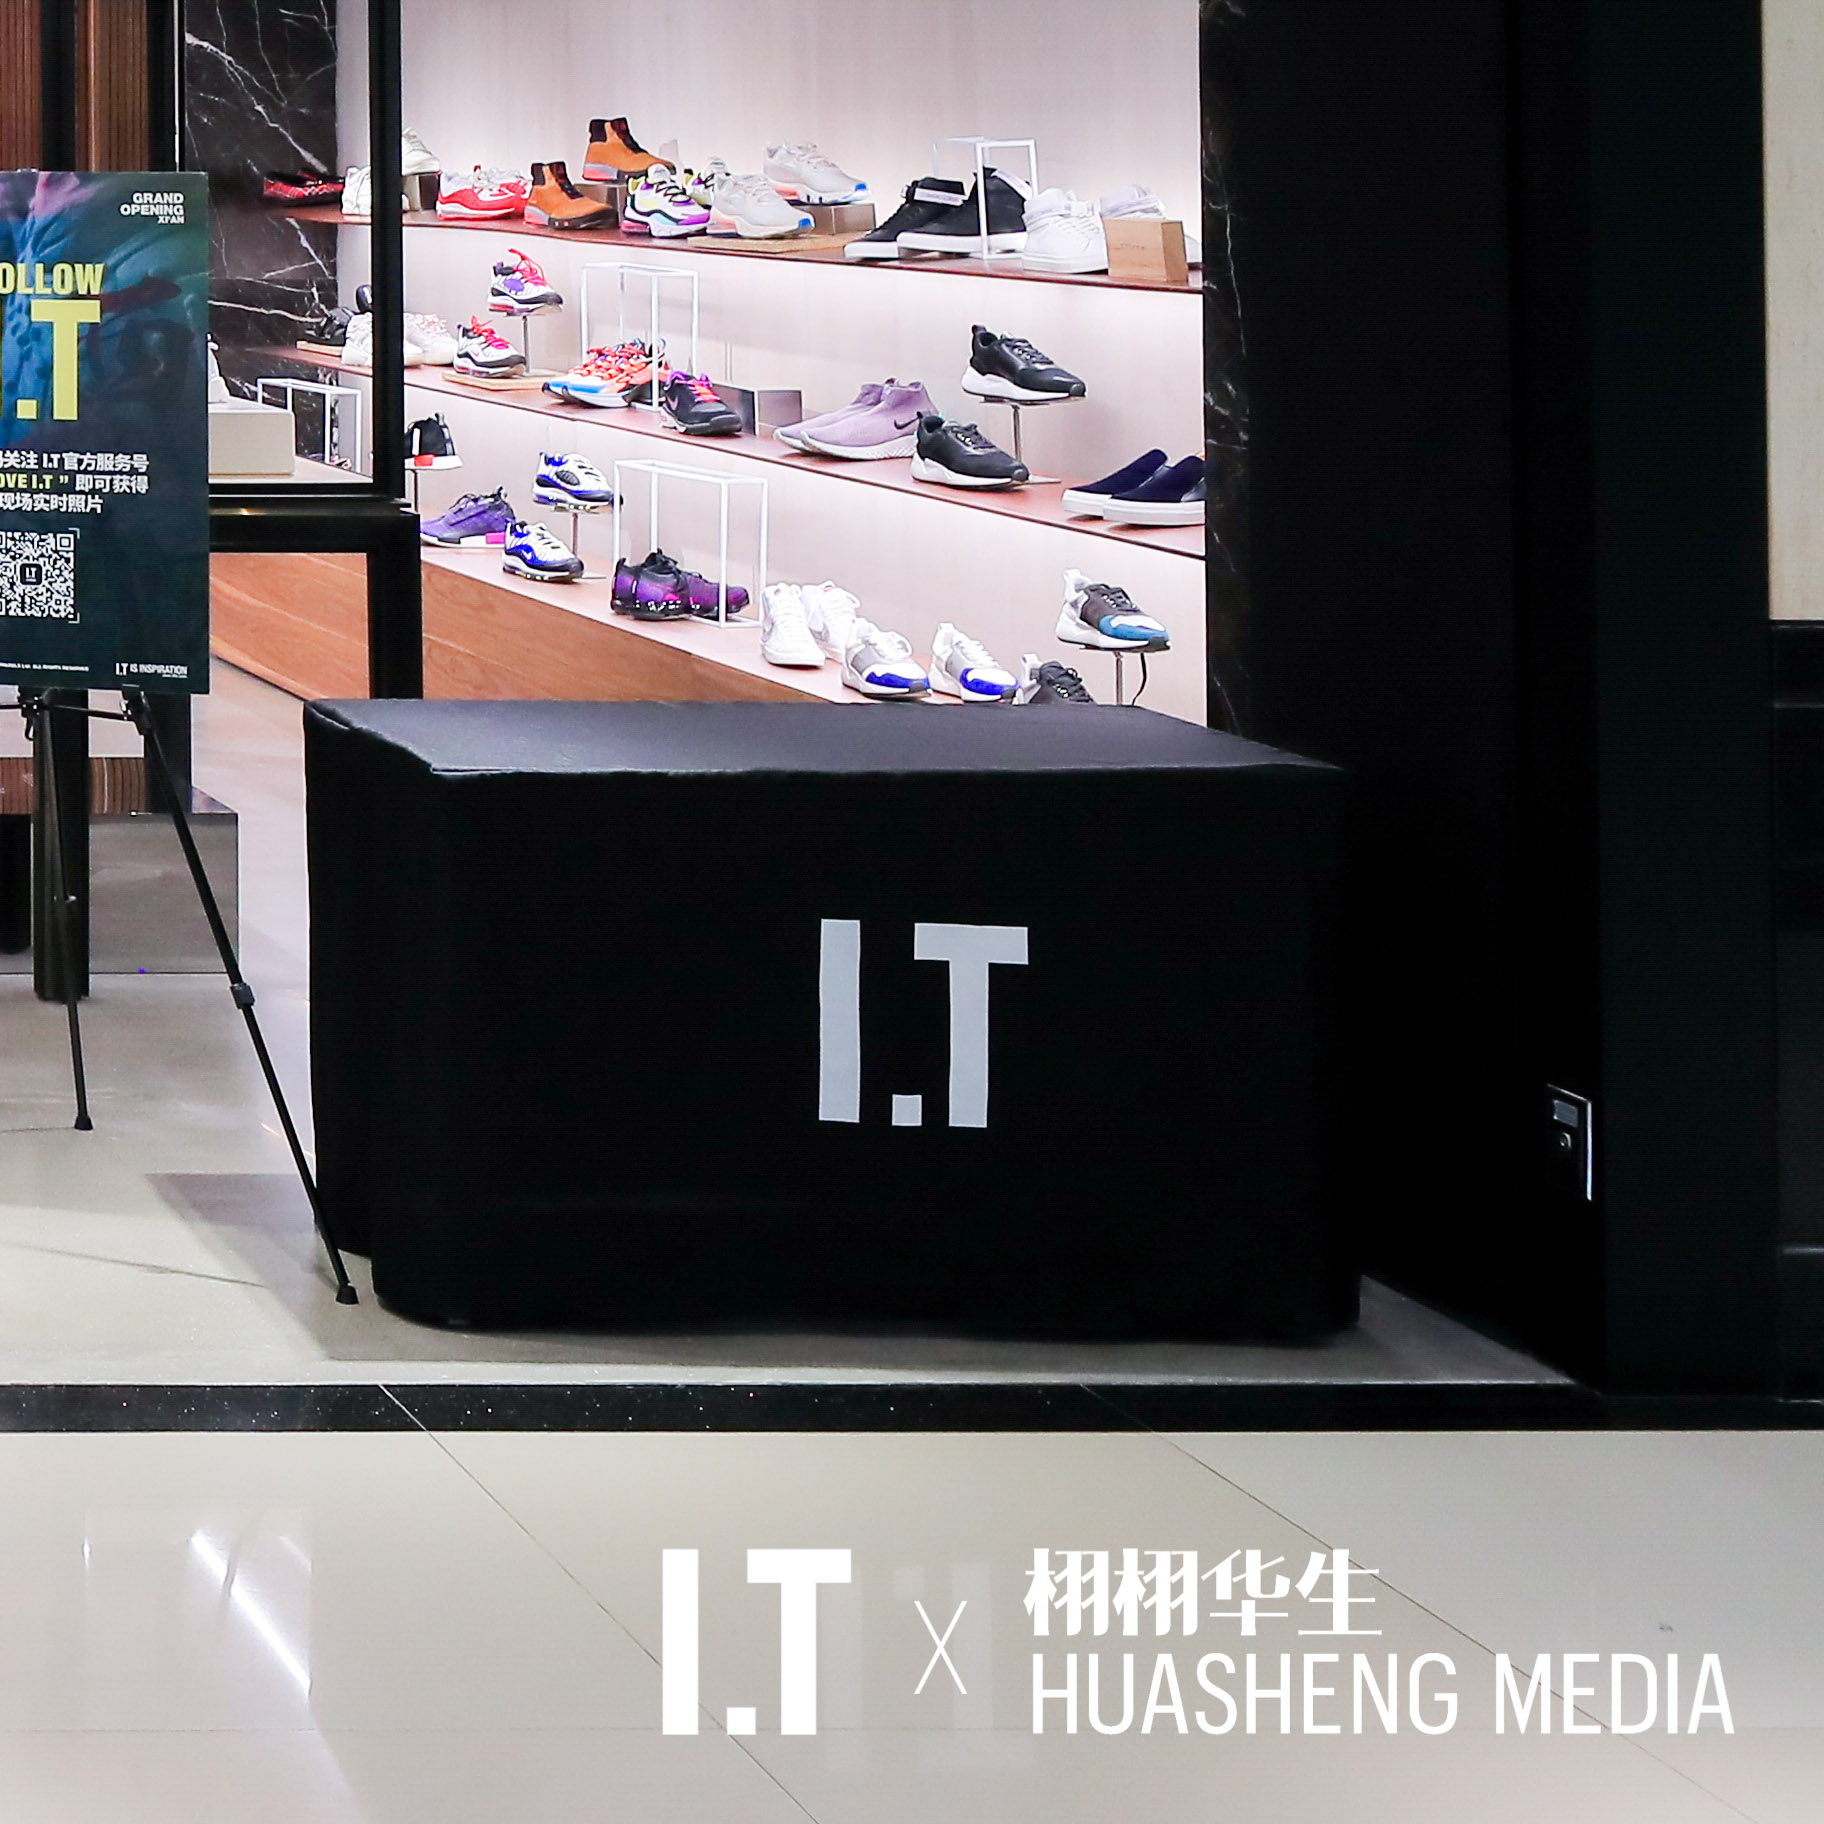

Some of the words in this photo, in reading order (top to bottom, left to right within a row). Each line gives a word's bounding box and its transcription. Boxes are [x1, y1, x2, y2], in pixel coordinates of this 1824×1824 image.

[132, 192, 185, 204] GRAND
[119, 203, 185, 216] OPENING
[42, 452, 61, 469] I.T
[62, 452, 150, 473] 官方服务号
[32, 475, 54, 489] I.T
[75, 474, 149, 494] 即可获得
[115, 662, 129, 676] I.T
[129, 663, 138, 673] IS
[139, 663, 188, 675] INSPIRATION
[819, 918, 1029, 1128] I.T
